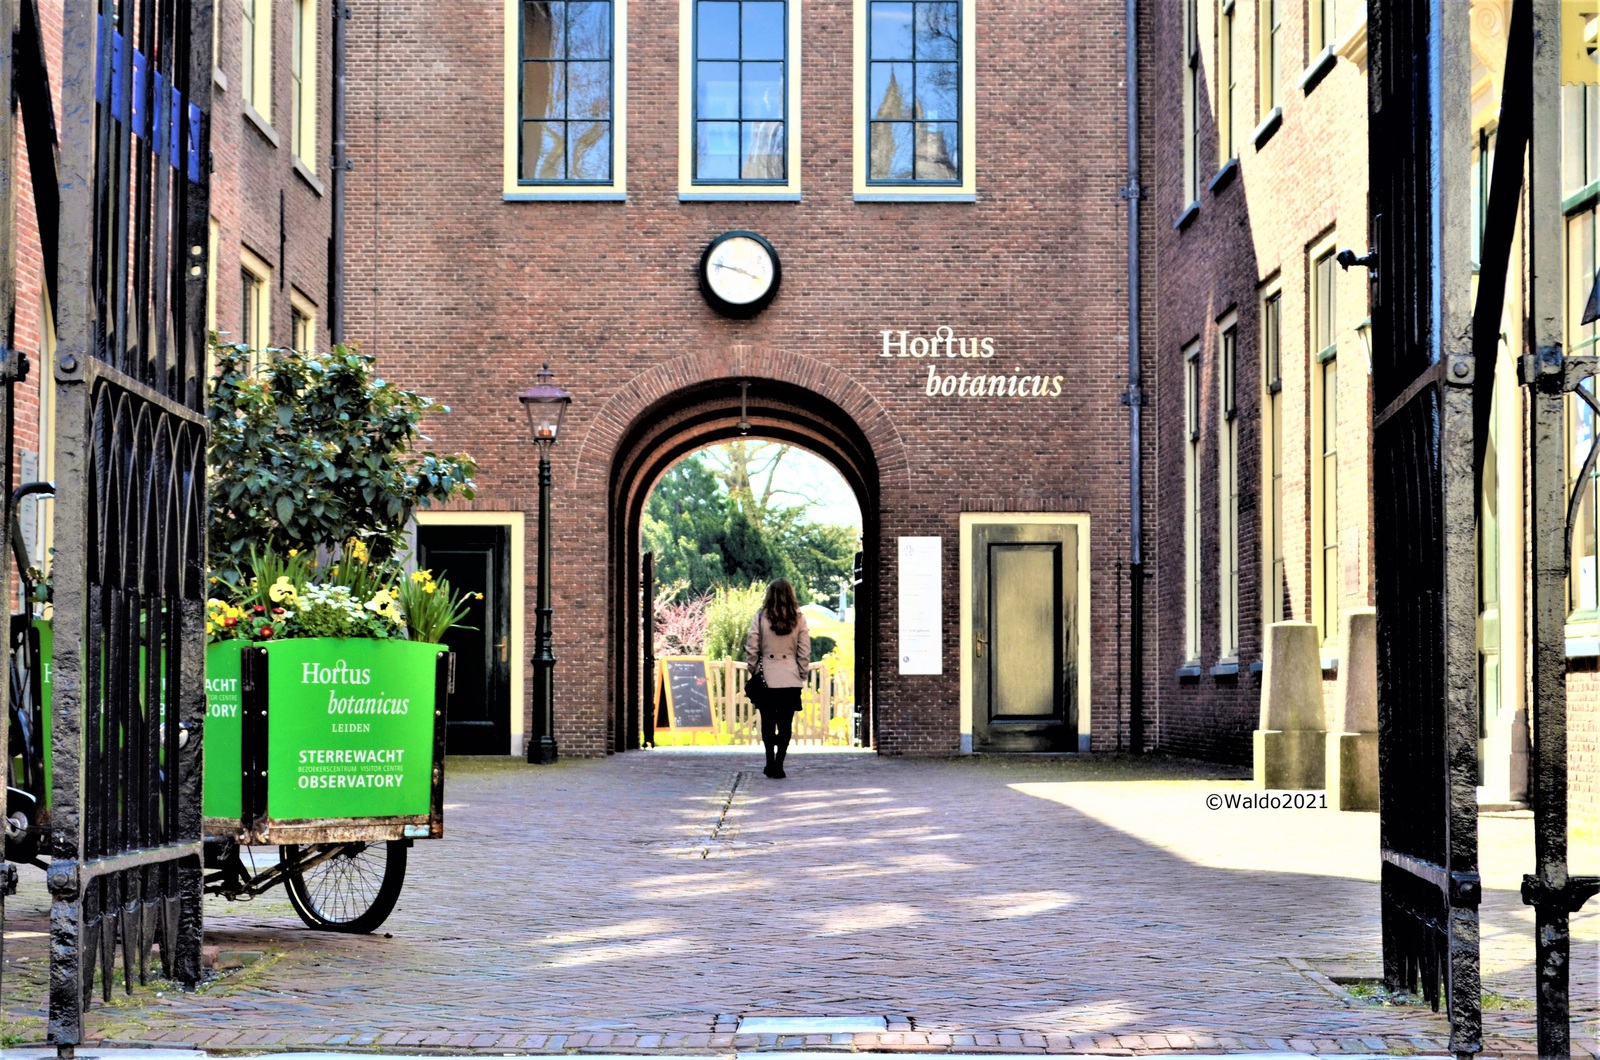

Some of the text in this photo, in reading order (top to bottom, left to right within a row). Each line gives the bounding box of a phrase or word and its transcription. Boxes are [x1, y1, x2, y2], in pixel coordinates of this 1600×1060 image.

[879, 325, 995, 358] Hortus
[925, 364, 1064, 397] botanicus
[300, 659, 371, 685] Hortus
[327, 689, 410, 715] botanicus
[331, 723, 371, 732] LEIDEN
[298, 749, 405, 764] STERREWACHT
[298, 774, 404, 789] OBSERVATORY
